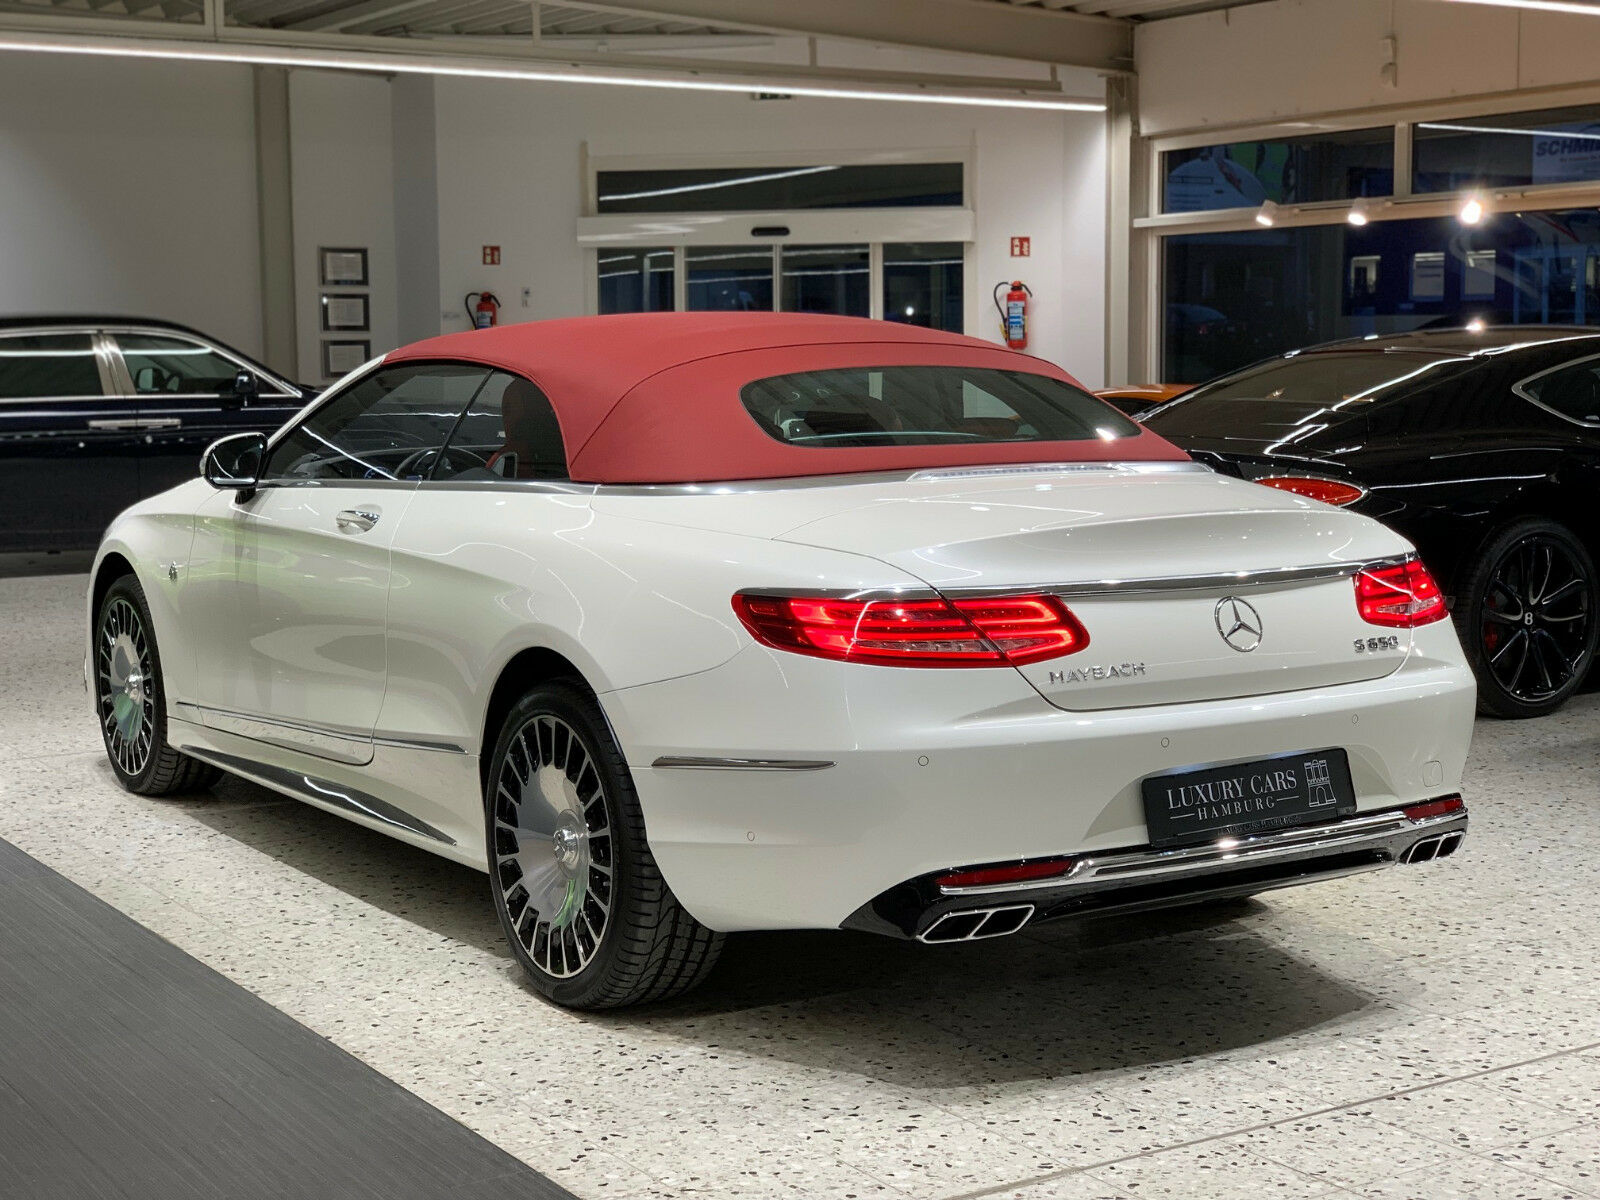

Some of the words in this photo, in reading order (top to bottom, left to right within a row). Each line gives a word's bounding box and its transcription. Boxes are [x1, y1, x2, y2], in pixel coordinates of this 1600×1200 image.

[1353, 639, 1365, 653] S
[1367, 636, 1399, 652] 650
[1049, 662, 1146, 685] MAYBACH
[1166, 778, 1244, 810] LUXURY
[1250, 769, 1297, 795] CARS
[1198, 796, 1275, 820] HAMBURG
